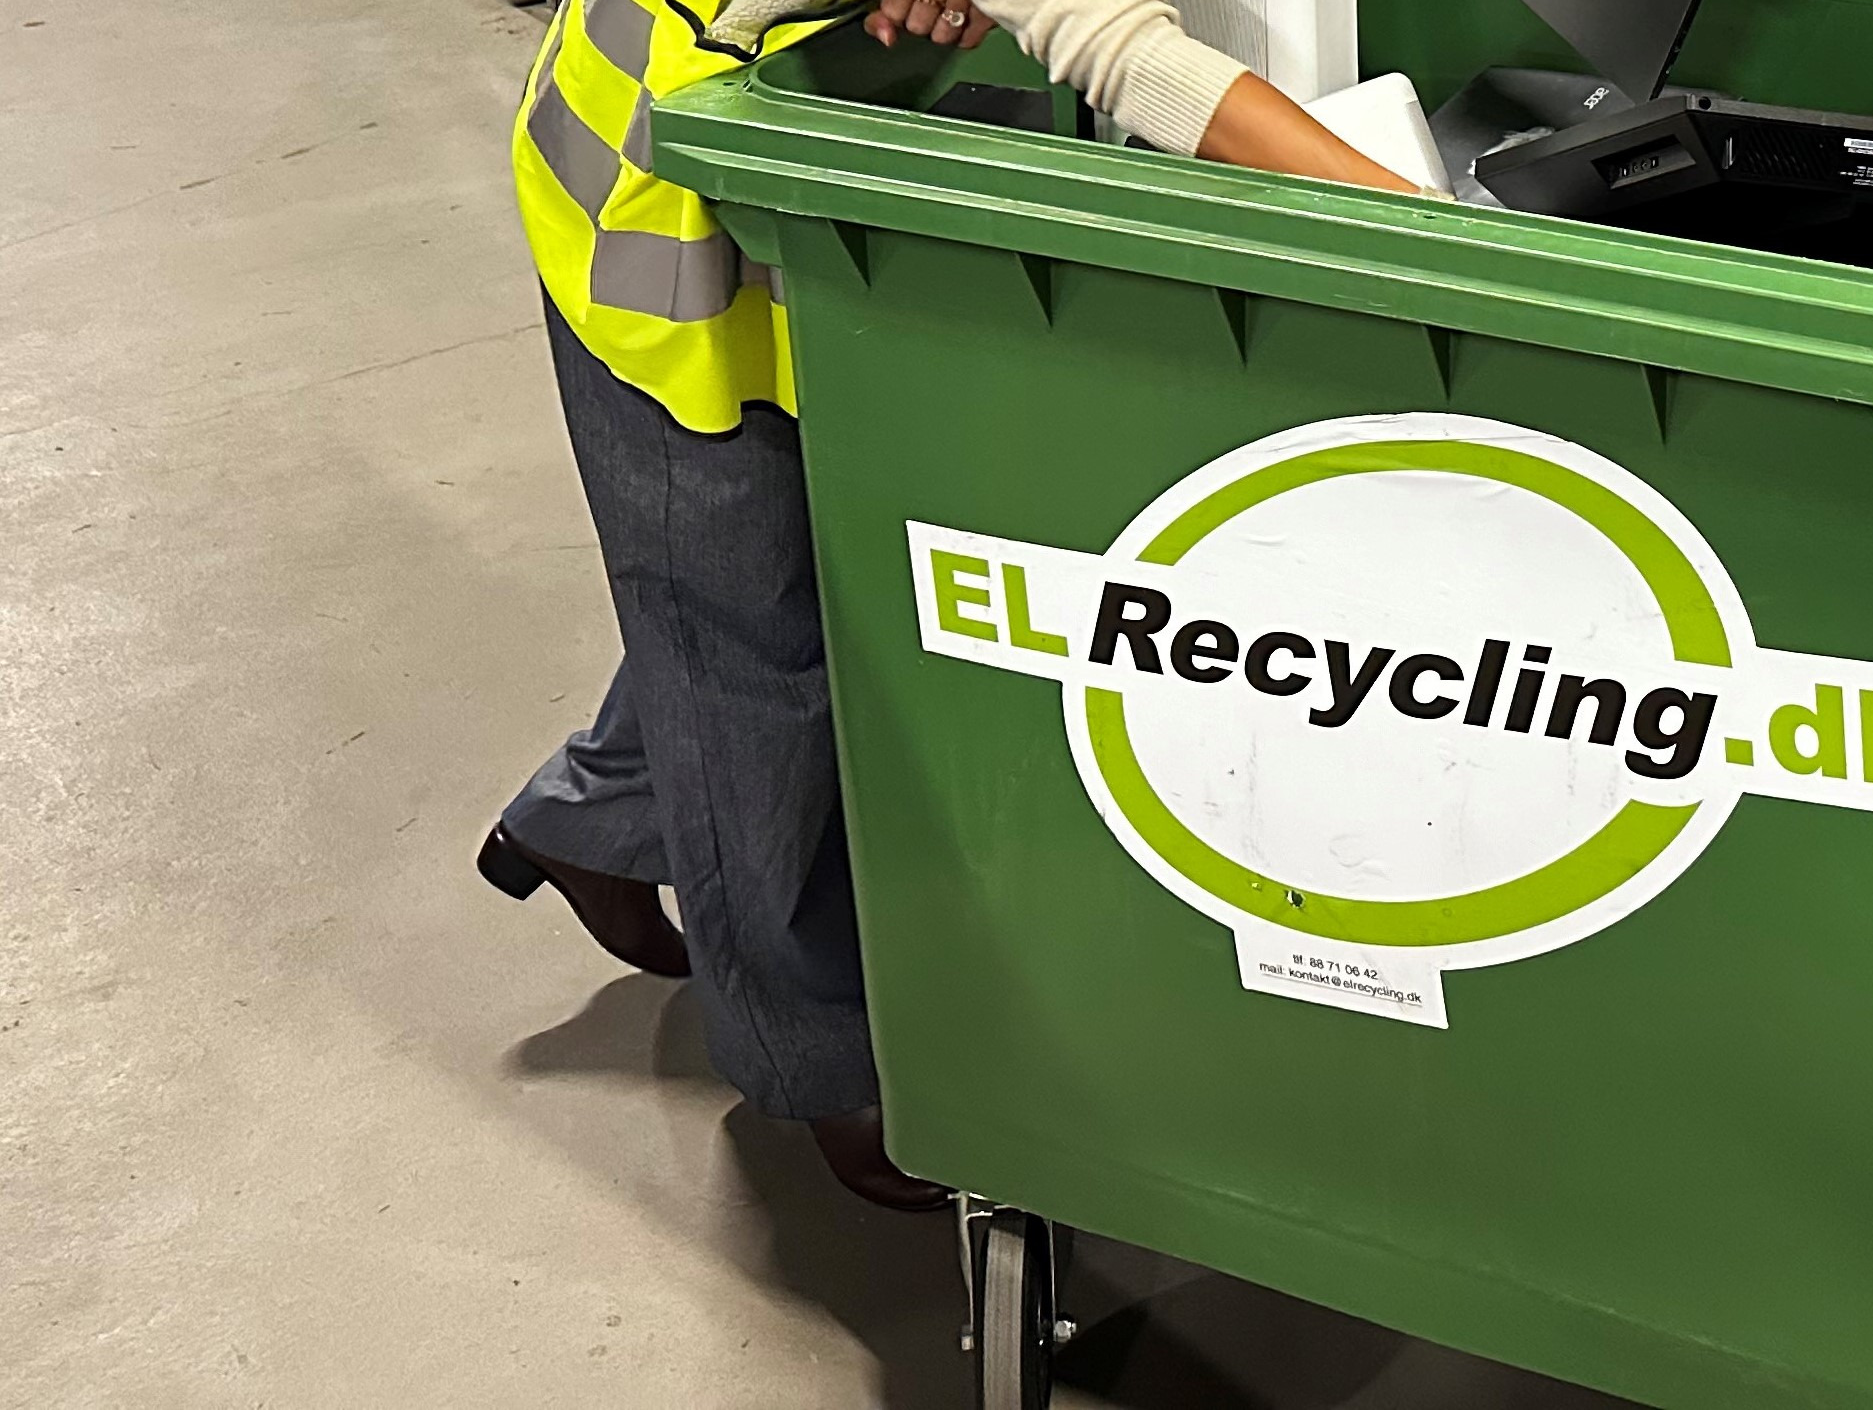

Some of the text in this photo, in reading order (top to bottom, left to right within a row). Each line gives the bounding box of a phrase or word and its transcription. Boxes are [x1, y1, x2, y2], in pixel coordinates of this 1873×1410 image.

[1583, 87, 1610, 110] acer
[930, 549, 1069, 657] EL
[1259, 962, 1422, 1004] mail: kontakt@elrecycling.dk
[1309, 957, 1325, 970] 88
[1327, 960, 1341, 973] 71
[1345, 964, 1360, 977] 06
[1363, 968, 1379, 980] 42
